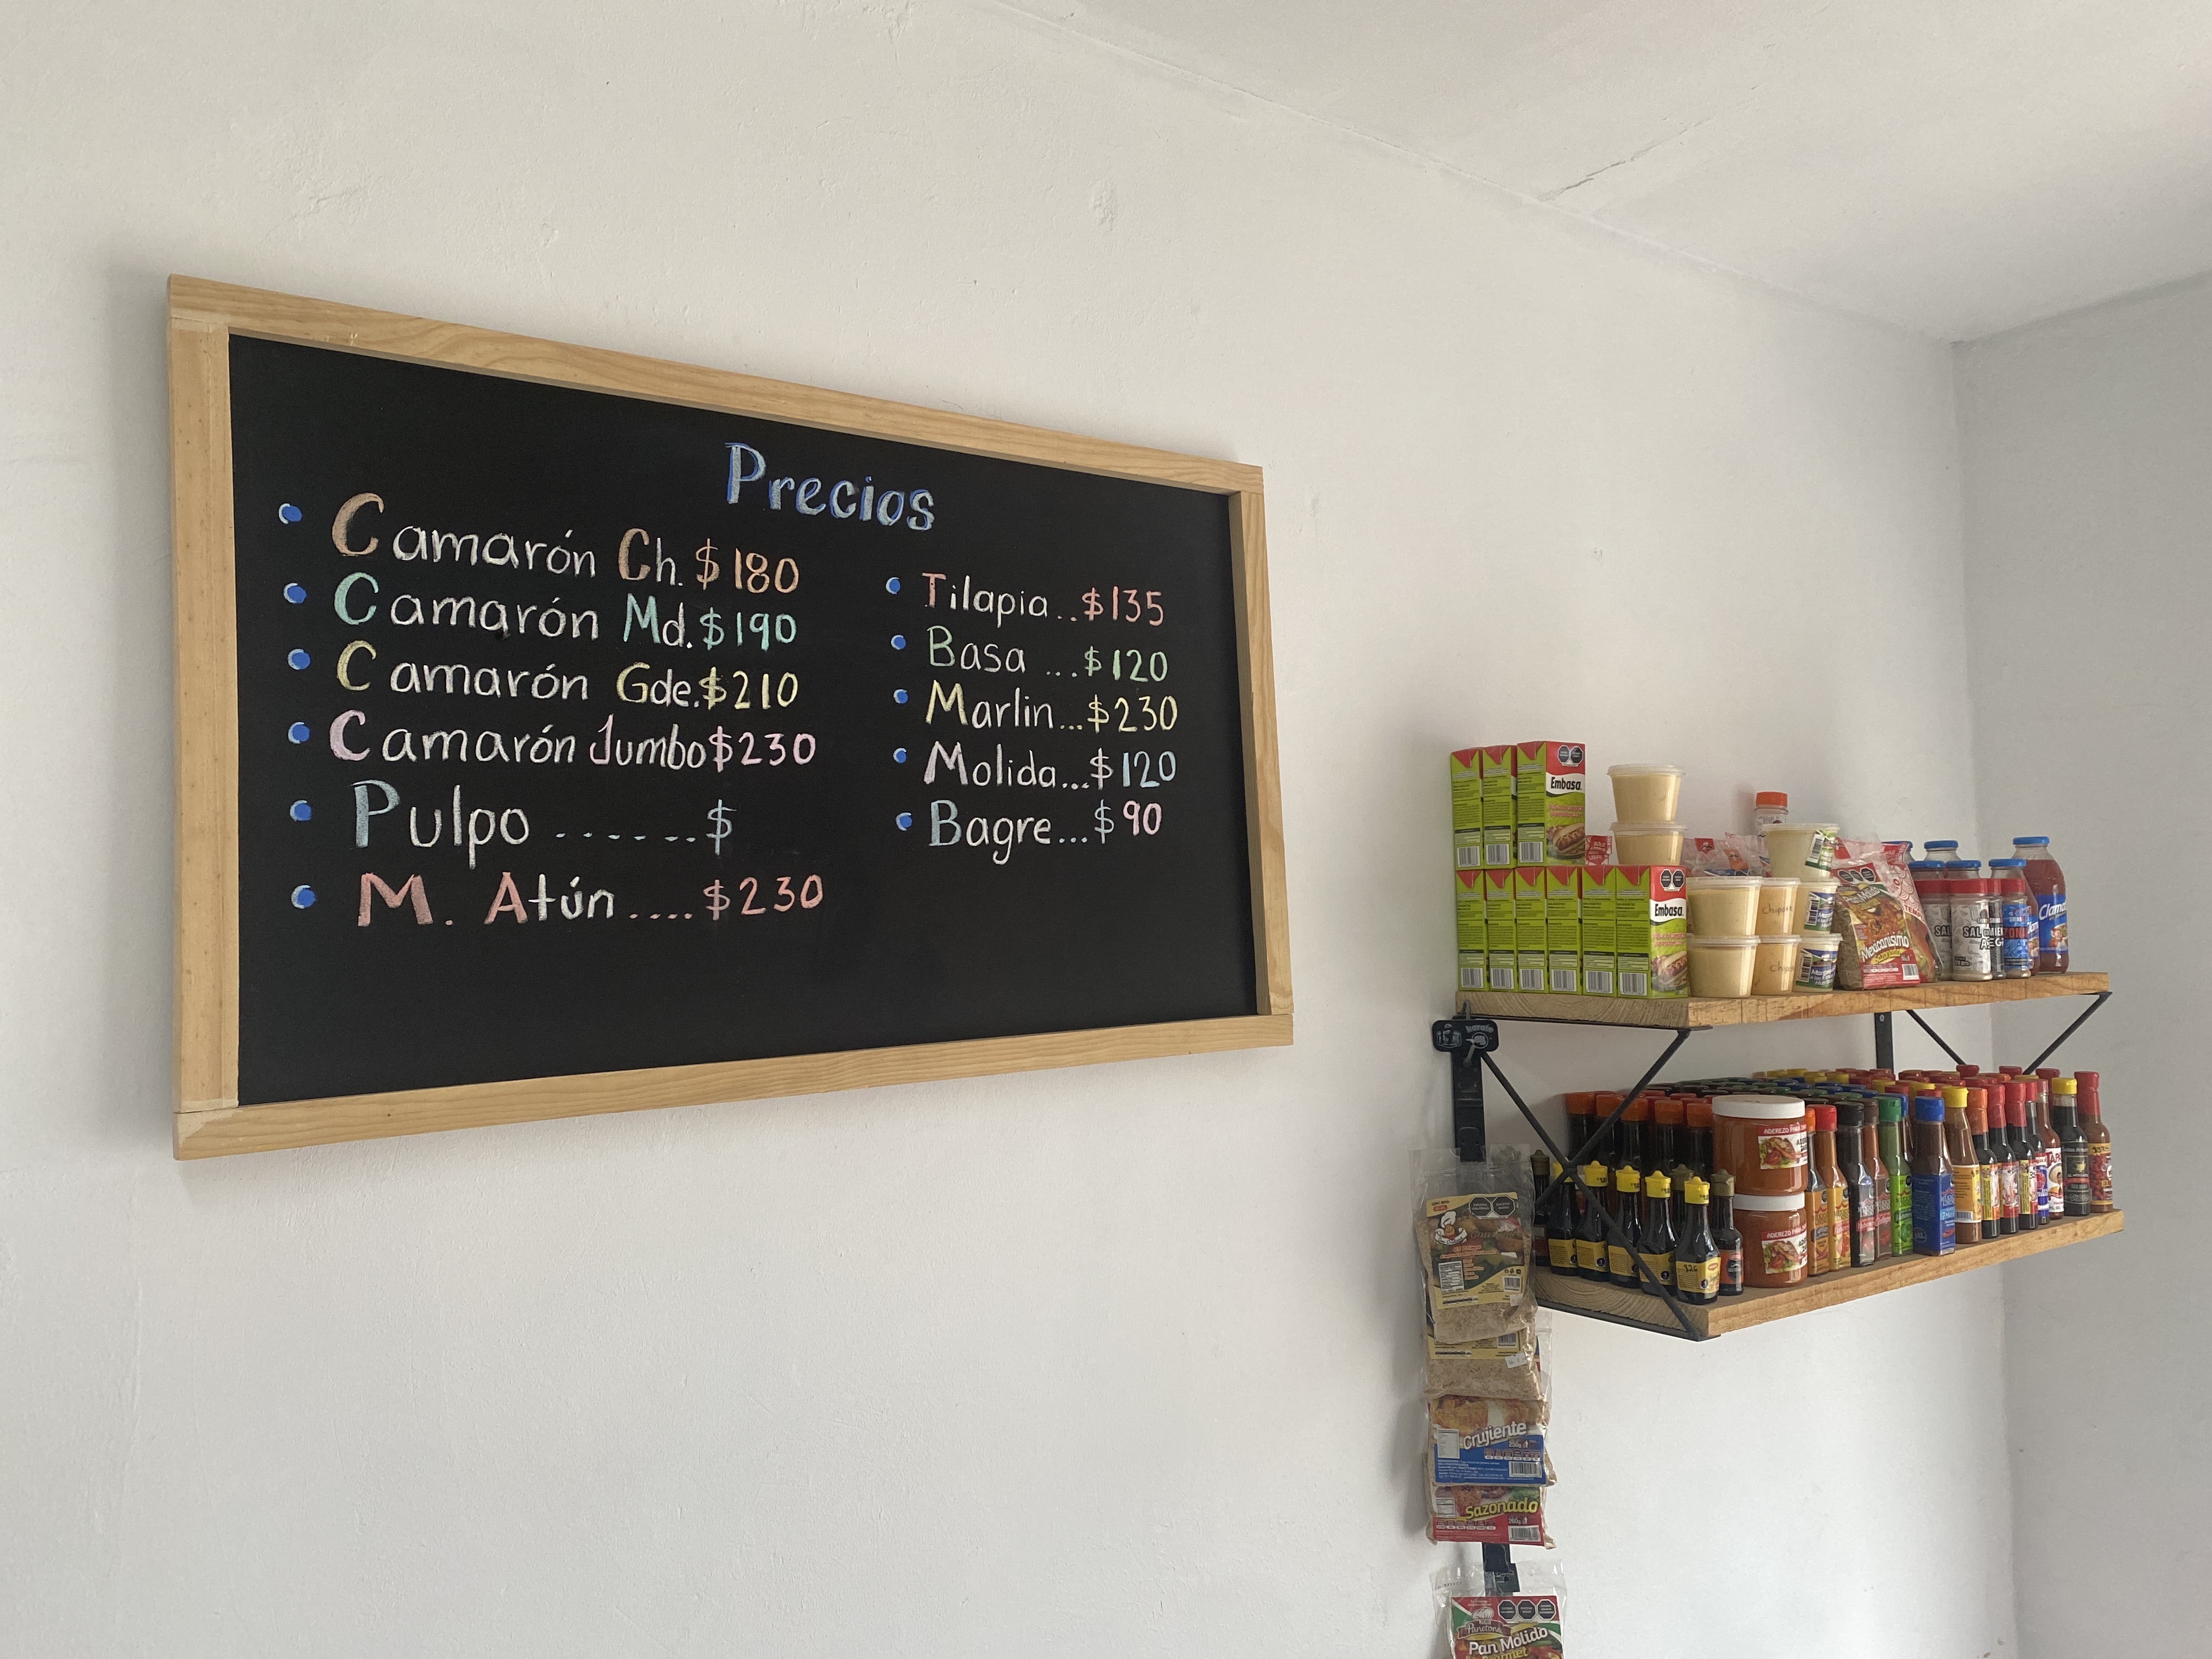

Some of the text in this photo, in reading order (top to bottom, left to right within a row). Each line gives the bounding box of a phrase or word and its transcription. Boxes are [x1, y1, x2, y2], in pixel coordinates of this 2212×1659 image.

[725, 442, 934, 531] Precios
[332, 492, 596, 578] Camarón
[618, 528, 684, 586] Ch.
[334, 572, 599, 640] Camarón
[623, 592, 692, 649] Md.
[922, 573, 1048, 628] Tilapia
[336, 640, 589, 700] Camarón
[616, 662, 699, 707] Gde.
[927, 625, 1026, 674] Basa
[925, 679, 1054, 729] Marlin
[329, 709, 575, 764] Camarón
[589, 714, 706, 770] Jumbo
[923, 741, 1057, 787] Molida
[1550, 776, 1582, 791] Embasa
[349, 779, 737, 870] Pulpo $
[928, 799, 1051, 865] Bagre
[357, 872, 454, 927] M.
[483, 872, 614, 924] Atún
[1655, 903, 1684, 917] Embasa
[1963, 926, 1982, 938] SAL
[1767, 1231, 1792, 1239] ADEREZO
[1463, 1421, 1527, 1450] Crujiente
[1465, 1497, 1538, 1520] Sazonado
[1469, 1627, 1548, 1655] Pan Molido
